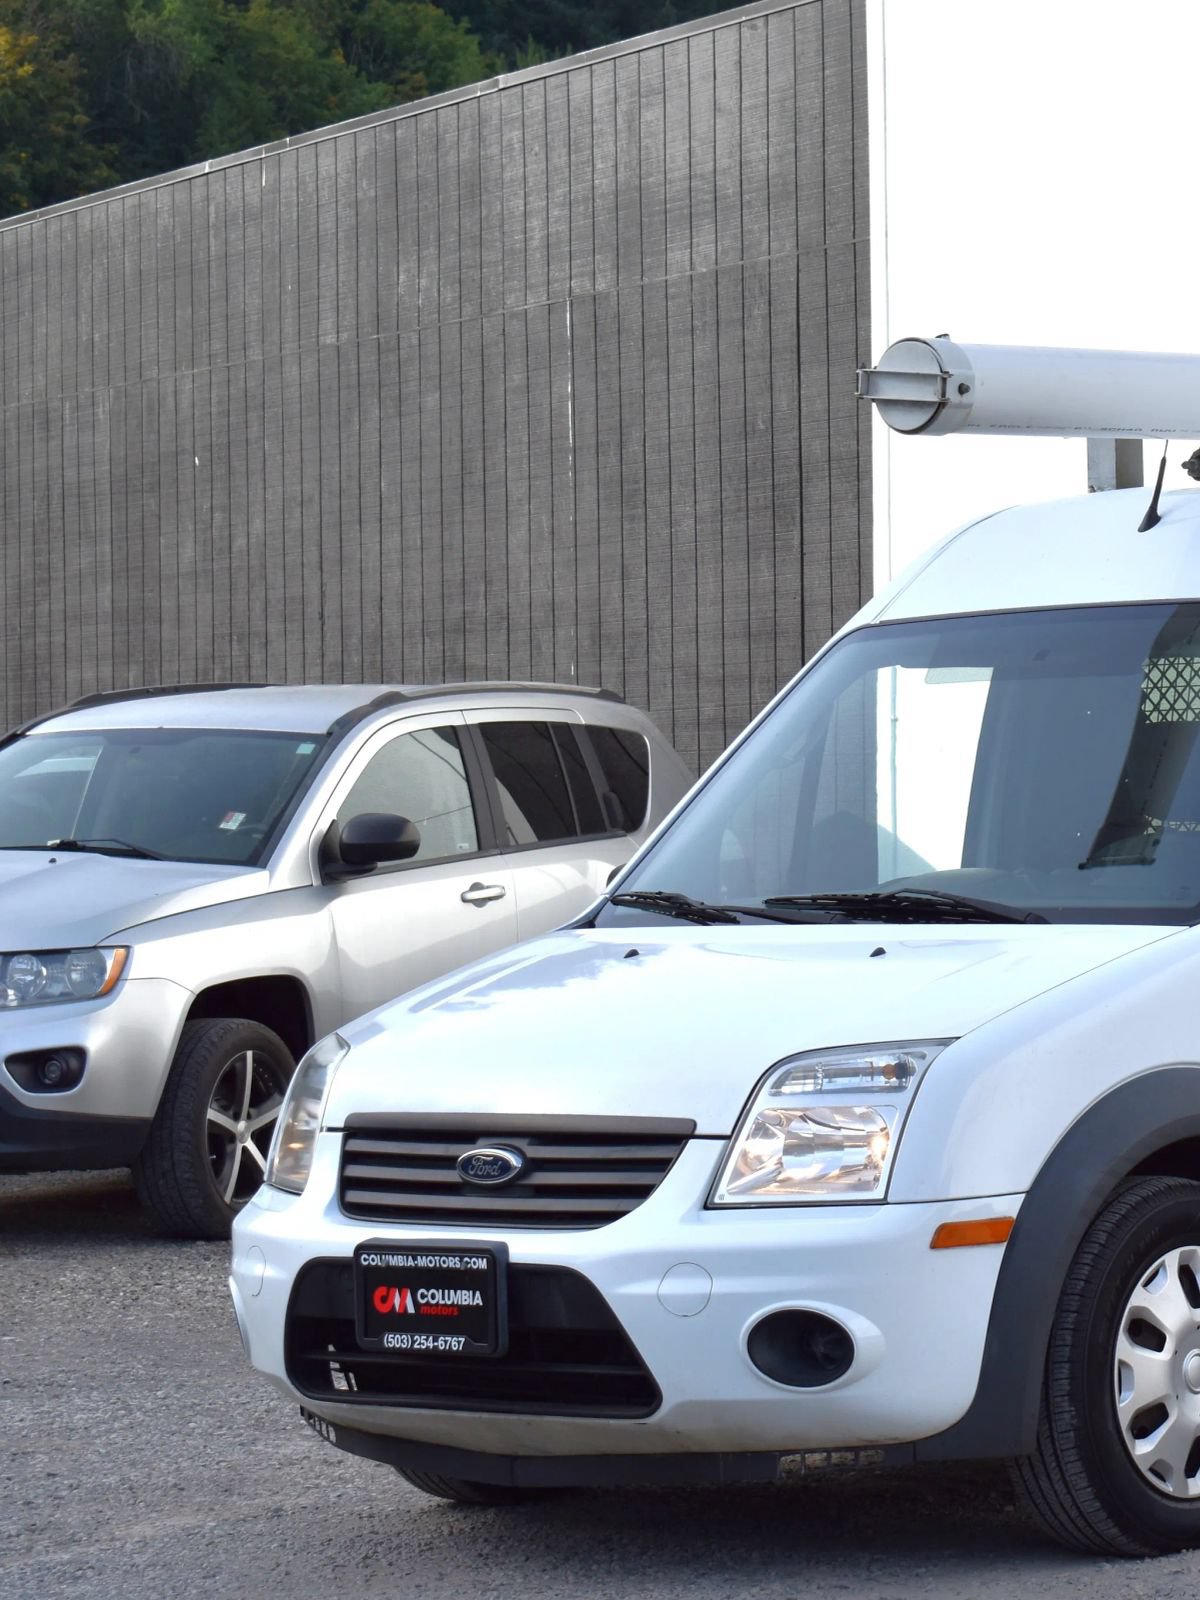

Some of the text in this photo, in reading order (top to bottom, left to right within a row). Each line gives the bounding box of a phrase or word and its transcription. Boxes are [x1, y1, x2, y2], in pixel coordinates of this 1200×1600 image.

[468, 1155, 502, 1176] Ford
[360, 1254, 488, 1270] COLUMBIA-MOTORSCOM
[417, 1288, 483, 1306] COLUMBIA
[420, 1305, 459, 1316] motors
[384, 1334, 465, 1350] (503) 254-6767
